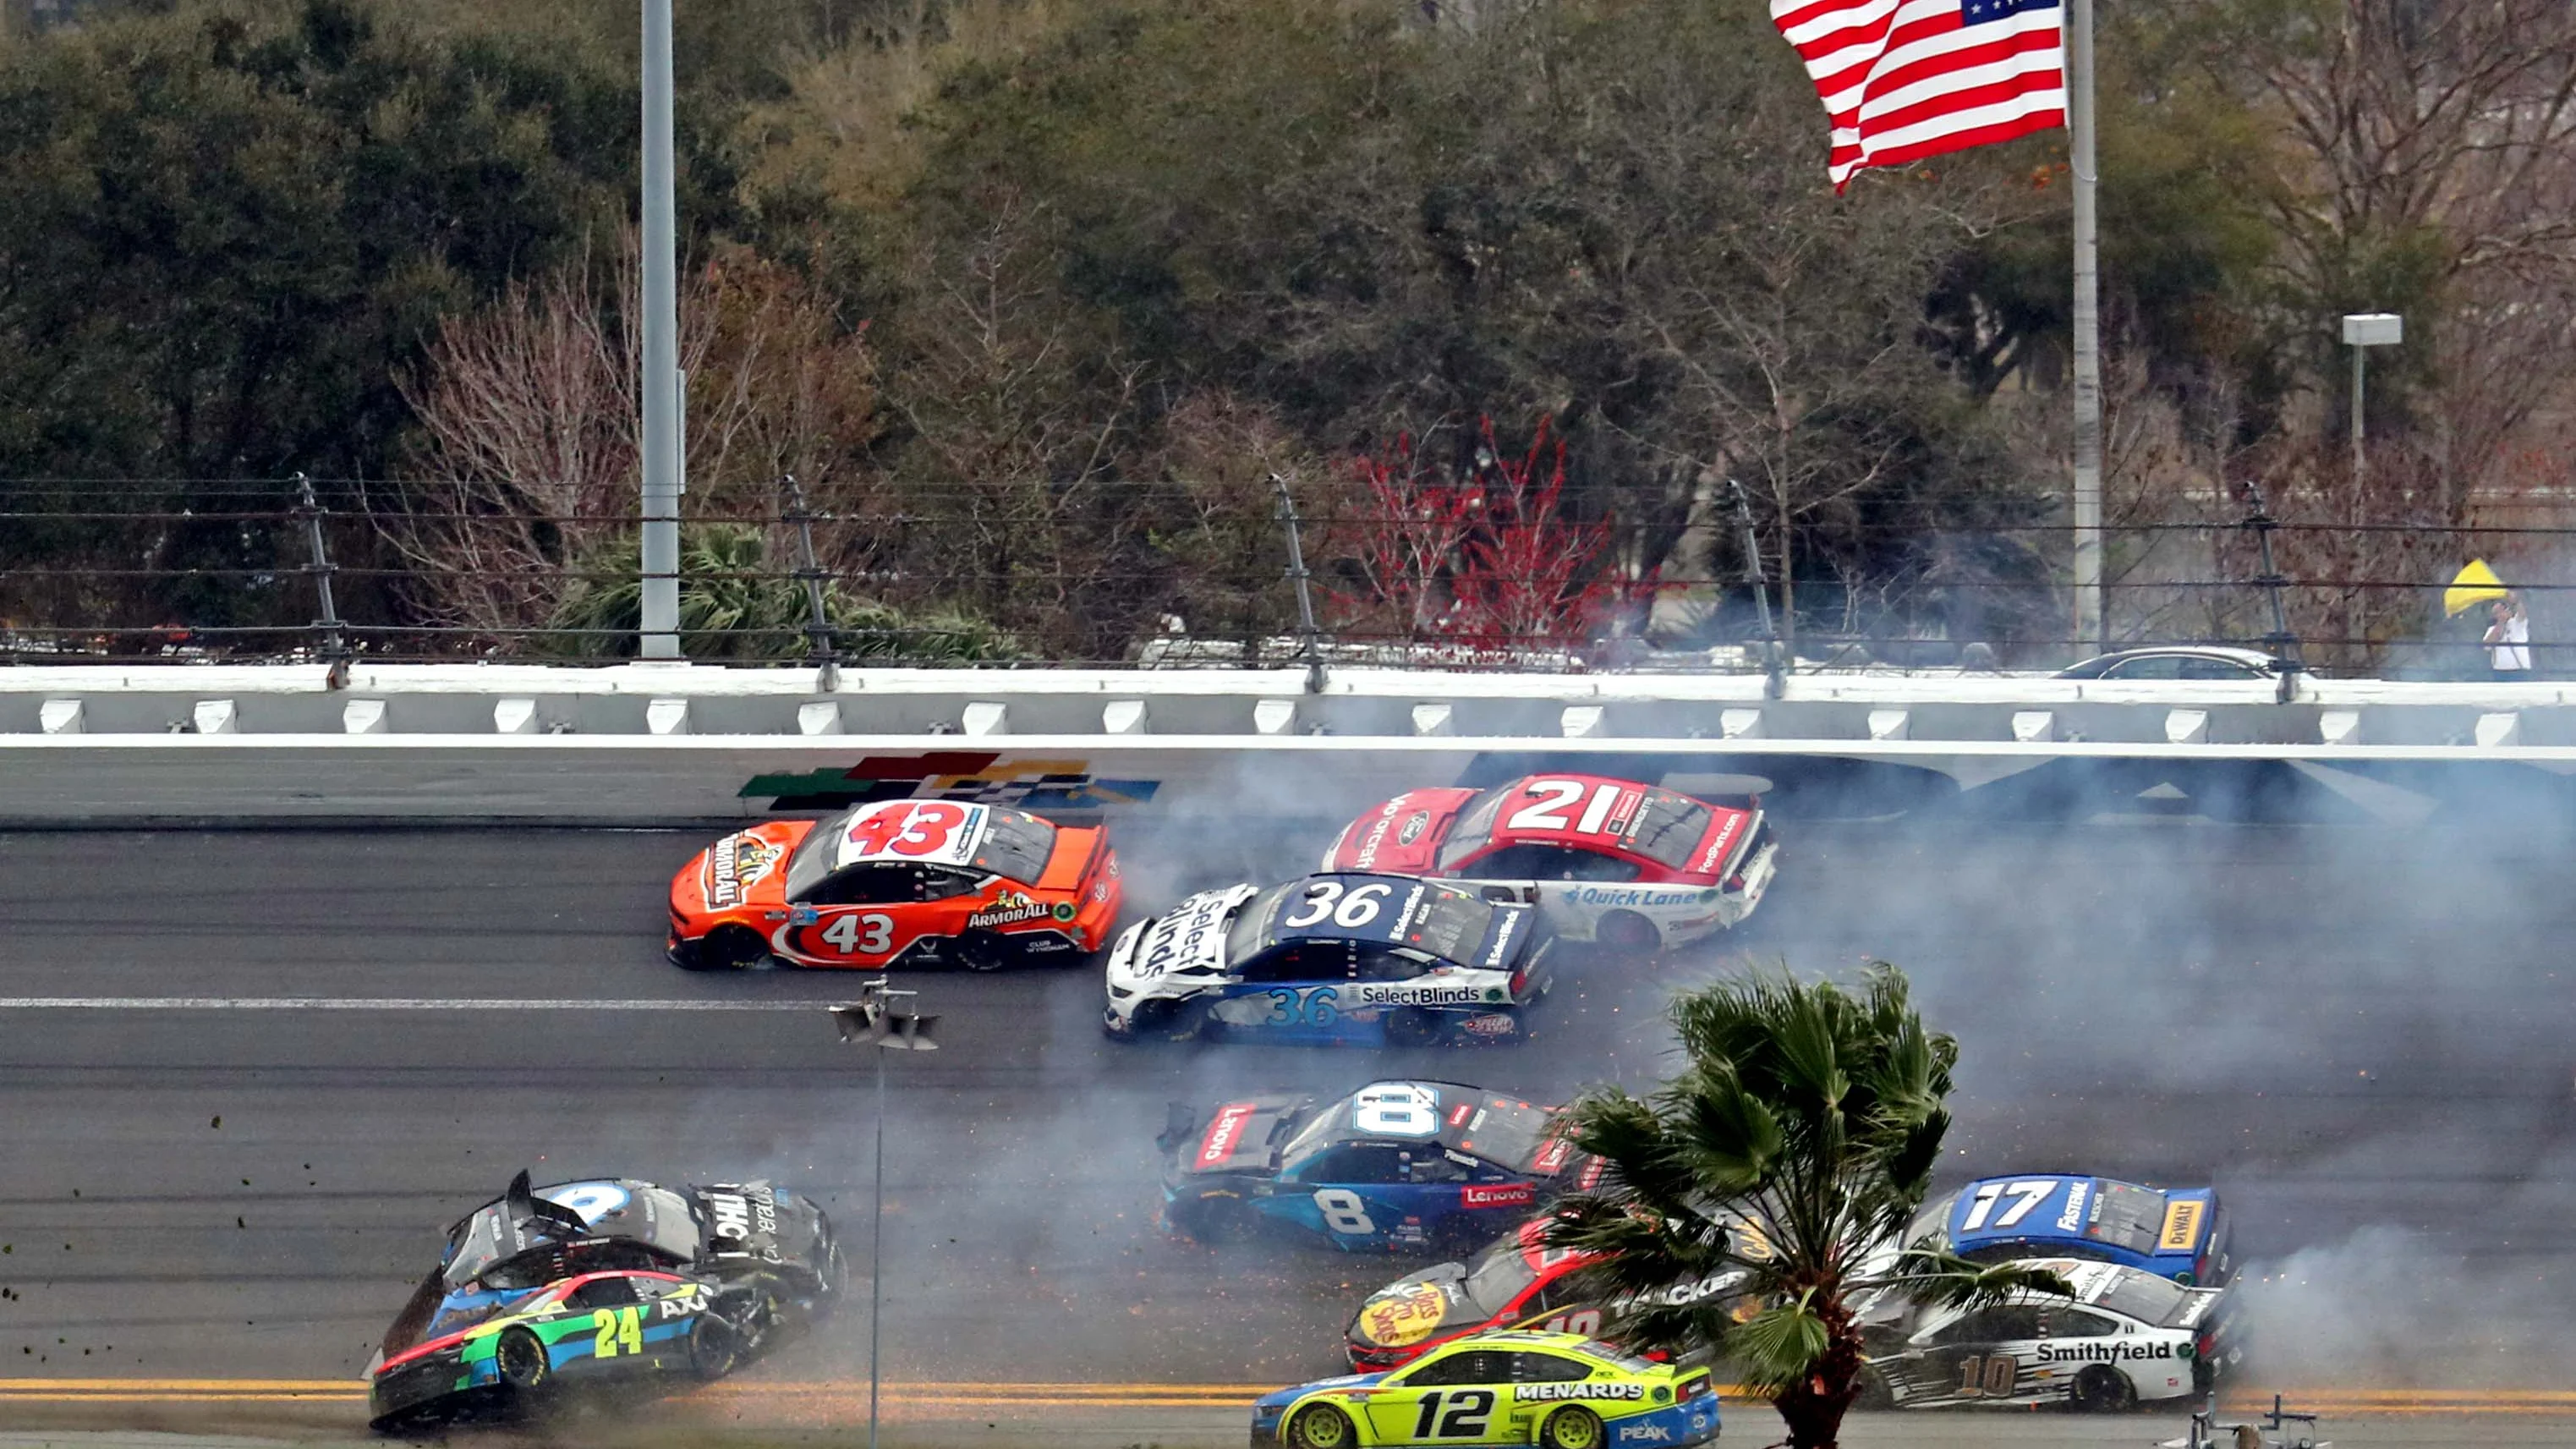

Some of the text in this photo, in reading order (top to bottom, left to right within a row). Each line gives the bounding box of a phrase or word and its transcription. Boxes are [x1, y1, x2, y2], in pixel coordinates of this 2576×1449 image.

[847, 804, 965, 855] 43
[1507, 780, 1622, 835] 21
[1697, 814, 1741, 873] FordParts.com
[1285, 881, 1392, 929] 36
[1395, 883, 1425, 934] SelectBlinds
[1582, 886, 1698, 906] Quick Lane
[821, 914, 894, 954] 43
[1029, 940, 1051, 948] CLUB
[1177, 900, 1224, 967] Select
[1490, 909, 1520, 960] SelectBlinds
[1269, 987, 1338, 1027] 36
[1362, 986, 1480, 1005] SelectBlinds
[1204, 1107, 1247, 1161] Lenovo
[1353, 1084, 1439, 1137] 8
[1313, 1188, 1375, 1234] 8
[1466, 1188, 1528, 1203] Lenovo
[1961, 1180, 2059, 1232] 17
[2057, 1182, 2089, 1232] FASTENAL
[593, 1306, 642, 1358] 24
[2037, 1341, 2171, 1364] Smithfield
[1514, 1384, 1643, 1402] MENARDS
[1958, 1354, 2017, 1397] 10
[1414, 1390, 1495, 1438] 12
[1620, 1424, 1673, 1441] PEAK
